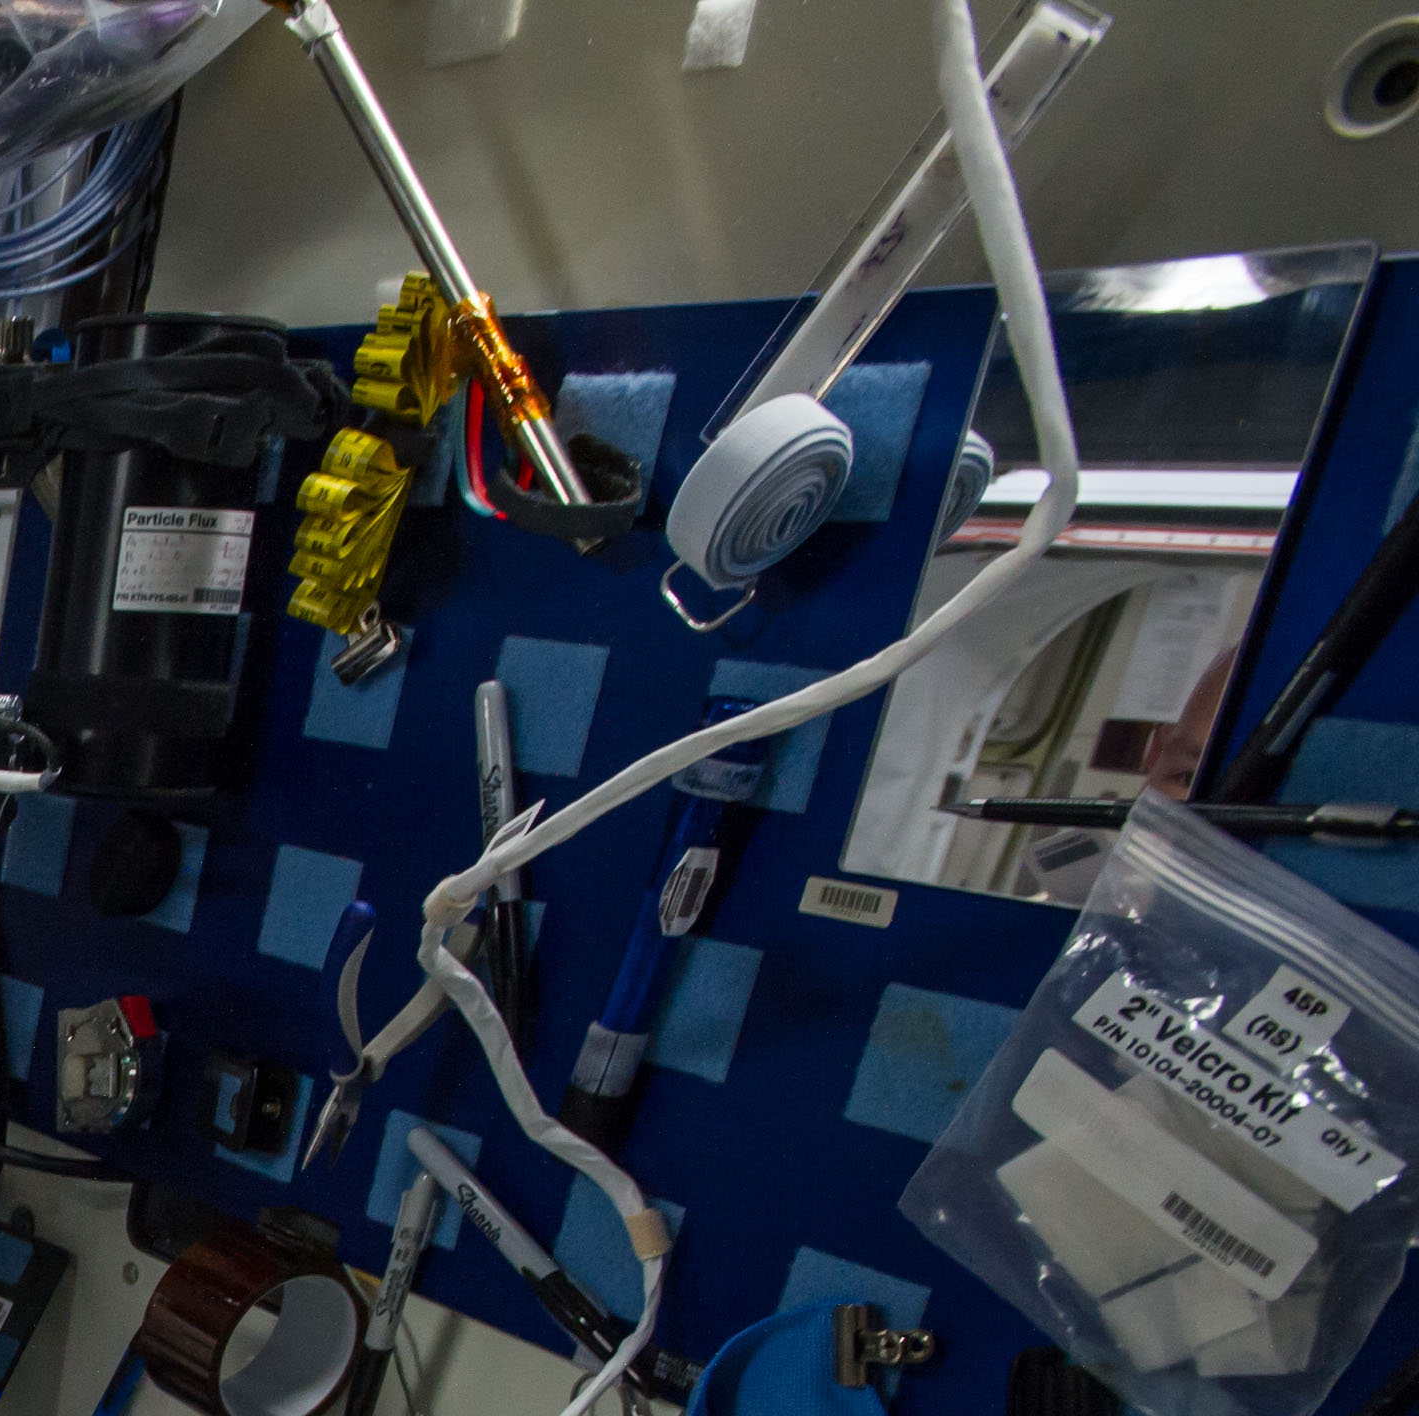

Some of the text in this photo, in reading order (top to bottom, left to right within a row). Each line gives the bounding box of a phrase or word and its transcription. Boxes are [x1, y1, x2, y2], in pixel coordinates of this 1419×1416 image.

[127, 512, 218, 528] Particle Flux
[1093, 1015, 1282, 1149] P/N 10104-20004-07
[1118, 995, 1302, 1124] 2" Velcro Kit
[1320, 1128, 1356, 1159] Qty
[458, 1183, 503, 1245] Sharpie
